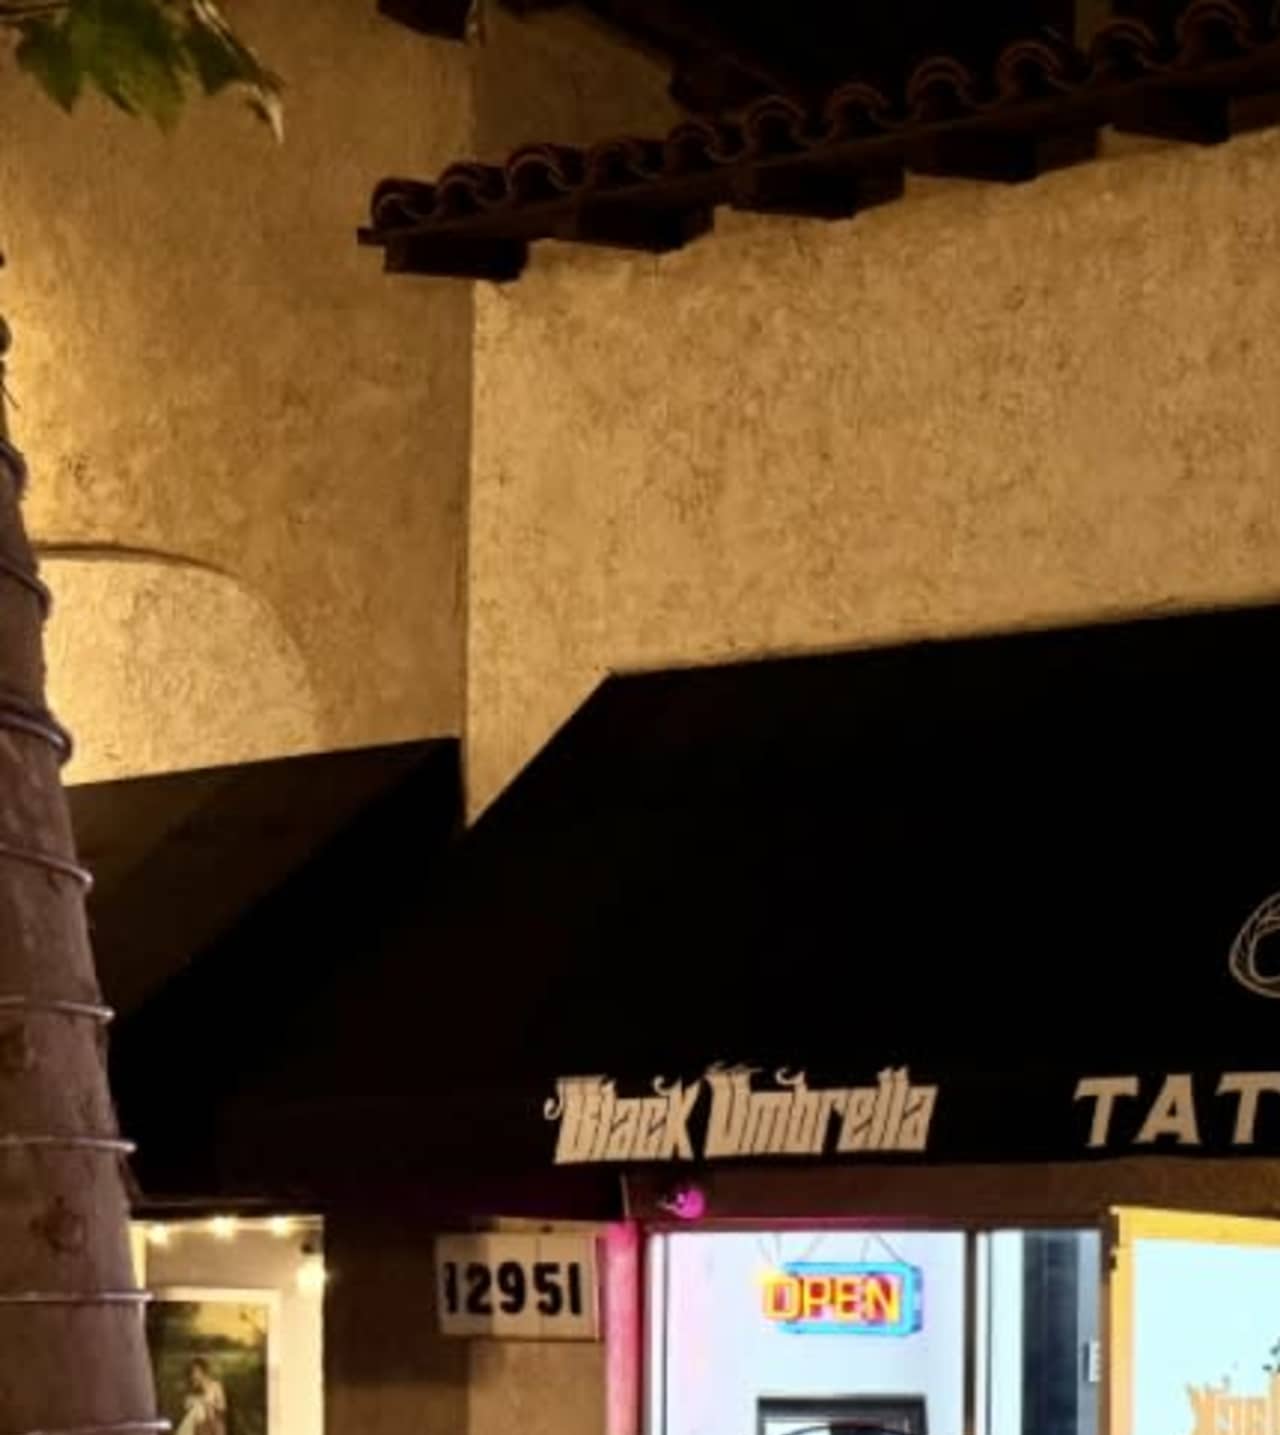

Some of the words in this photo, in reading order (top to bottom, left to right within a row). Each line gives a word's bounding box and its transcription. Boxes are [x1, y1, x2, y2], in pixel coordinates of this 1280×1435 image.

[704, 1061, 938, 1158] Umbrella
[443, 1261, 583, 1316] 12951
[761, 1272, 899, 1324] OPEN
